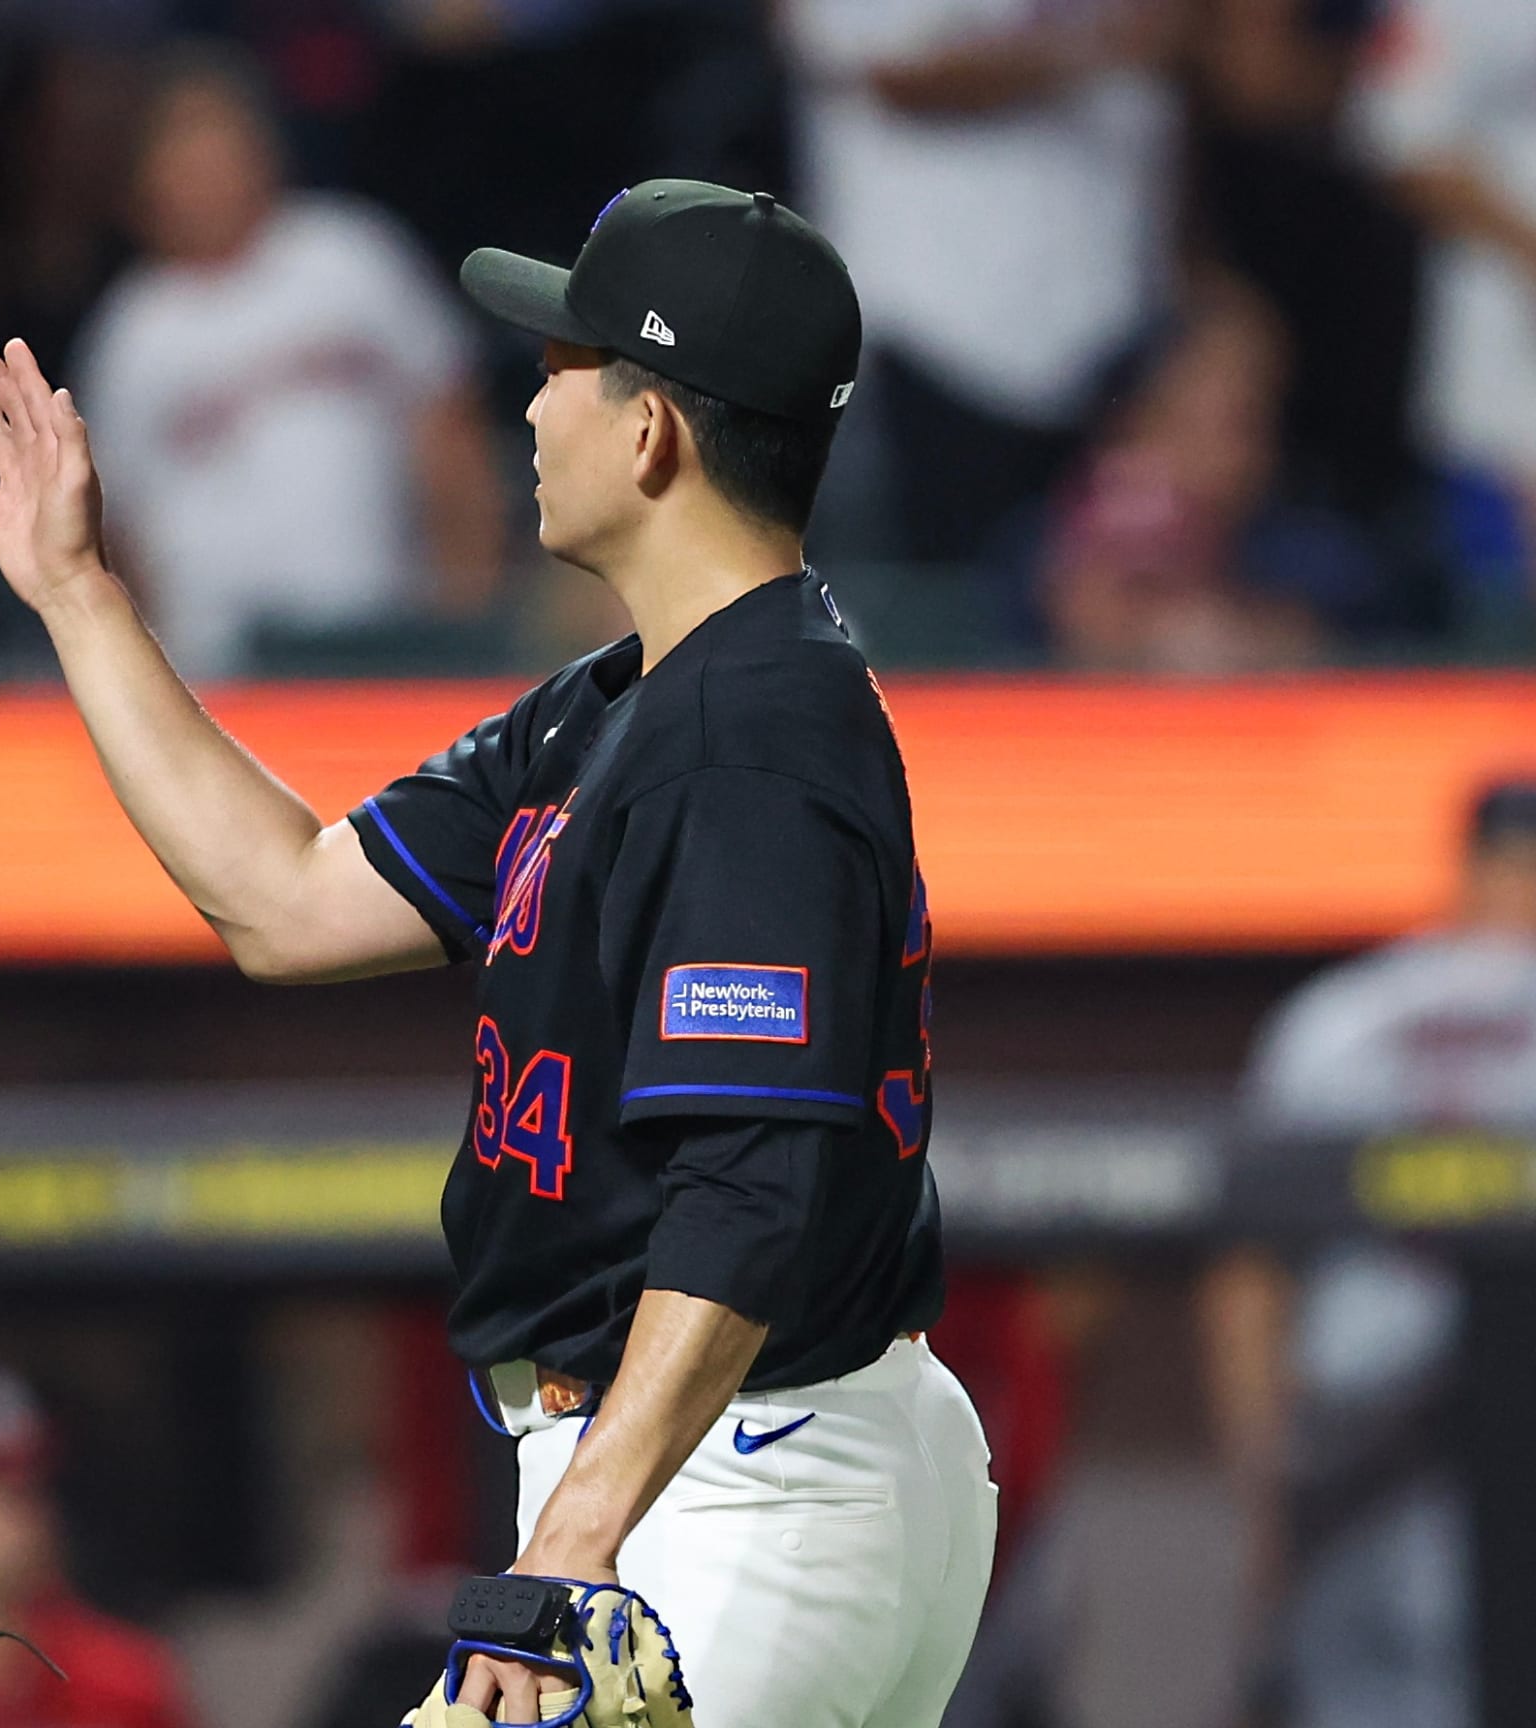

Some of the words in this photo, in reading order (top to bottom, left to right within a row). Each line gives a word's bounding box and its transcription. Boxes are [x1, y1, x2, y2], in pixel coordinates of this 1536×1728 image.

[691, 983, 775, 1000] NewYork-
[691, 1001, 796, 1021] Presbyterian
[473, 1015, 572, 1200] 34
